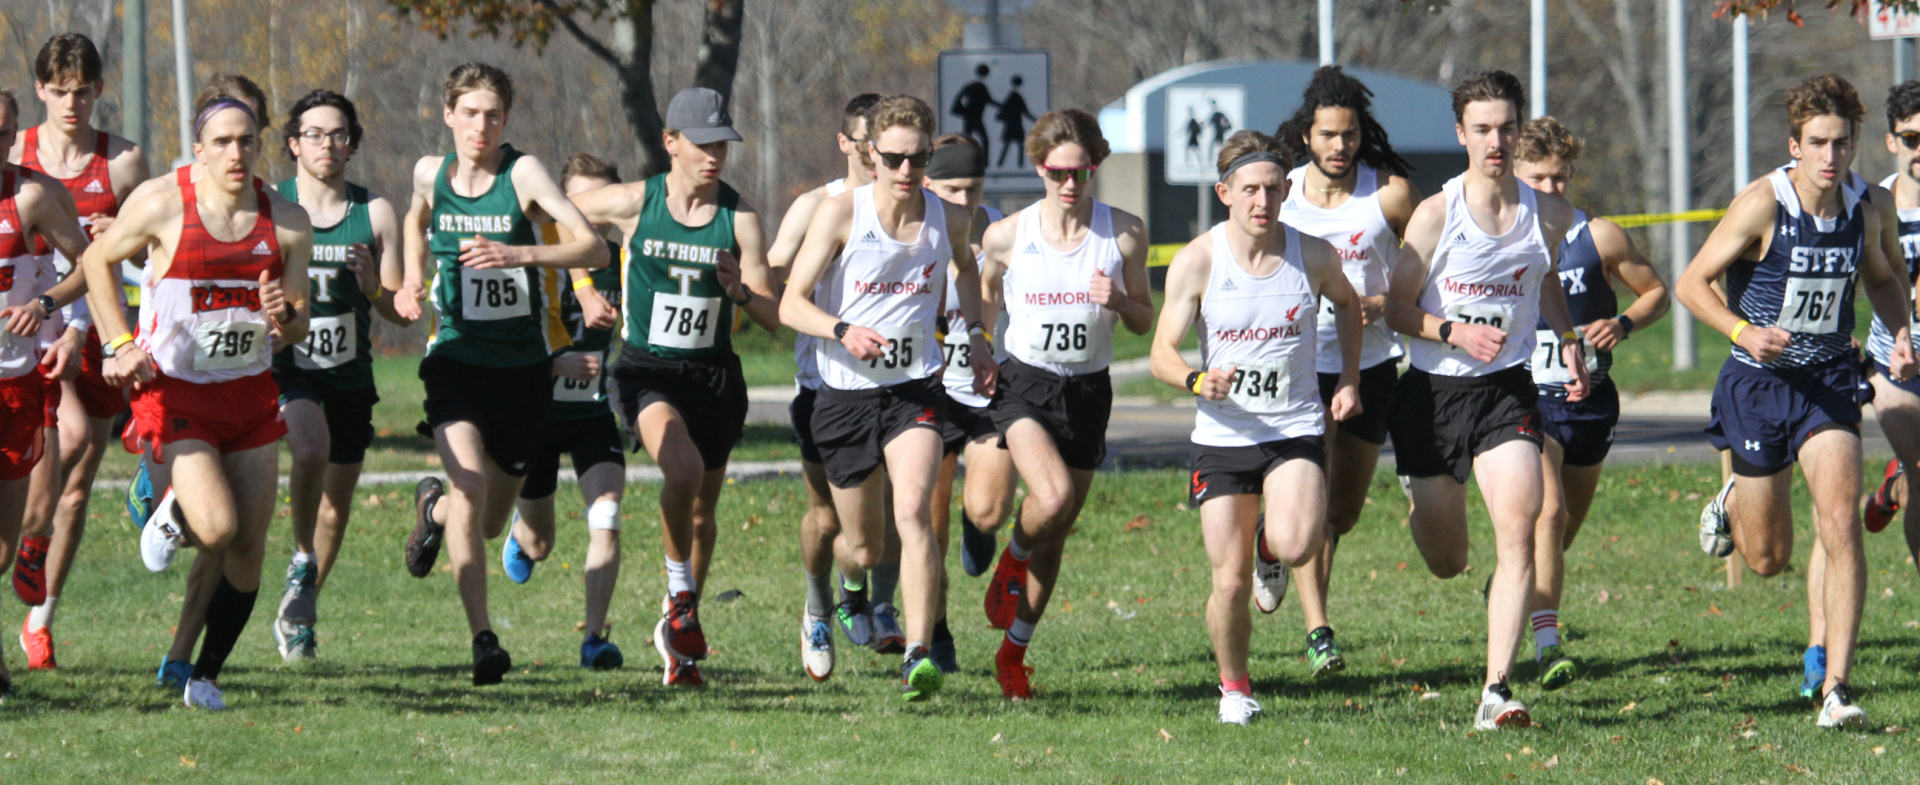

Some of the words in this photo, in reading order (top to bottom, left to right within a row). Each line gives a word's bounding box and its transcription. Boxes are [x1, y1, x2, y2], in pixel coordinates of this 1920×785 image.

[455, 214, 513, 233] THOMAS
[668, 241, 730, 265] THOM
[1789, 245, 1856, 273] STFX
[470, 277, 518, 308] 785
[668, 264, 702, 297] T
[1444, 278, 1525, 298] MEMORIAL
[190, 285, 261, 314] REDS
[1025, 292, 1091, 306] MEMORI
[1793, 290, 1837, 322] 762
[663, 305, 709, 337] 784
[1216, 323, 1302, 342] MEMORIAL
[207, 330, 255, 358] 796
[307, 325, 348, 357] 782
[1041, 323, 1088, 351] 736
[1233, 369, 1279, 399] 734
